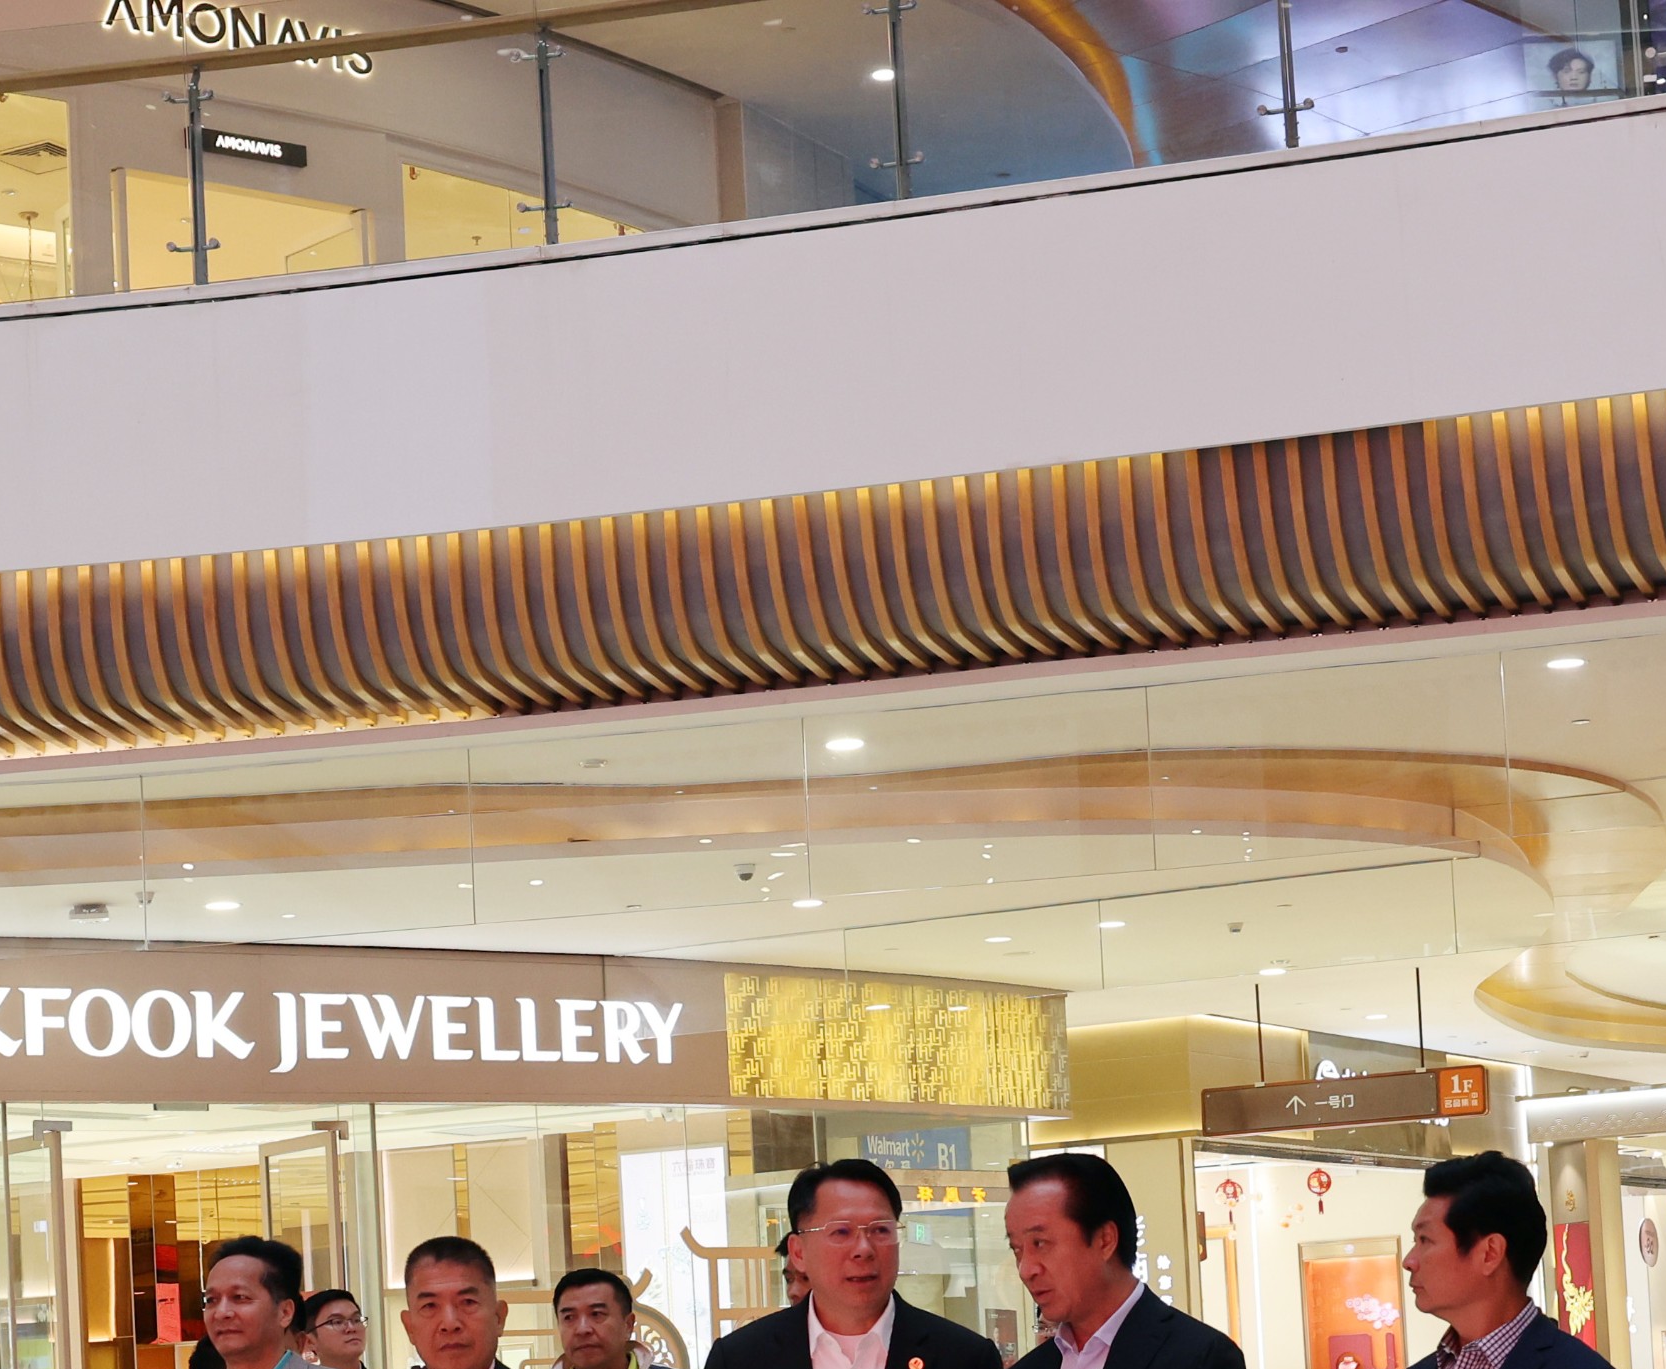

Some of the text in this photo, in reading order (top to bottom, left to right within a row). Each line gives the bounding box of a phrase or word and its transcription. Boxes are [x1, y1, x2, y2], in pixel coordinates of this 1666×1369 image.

[215, 135, 282, 158] AMONAVIS
[270, 991, 684, 1074] JEWELLERY
[1451, 1074, 1473, 1094] 1F
[1314, 1094, 1355, 1109] 一号门
[867, 1135, 910, 1157] Walmart
[937, 1143, 957, 1170] B1
